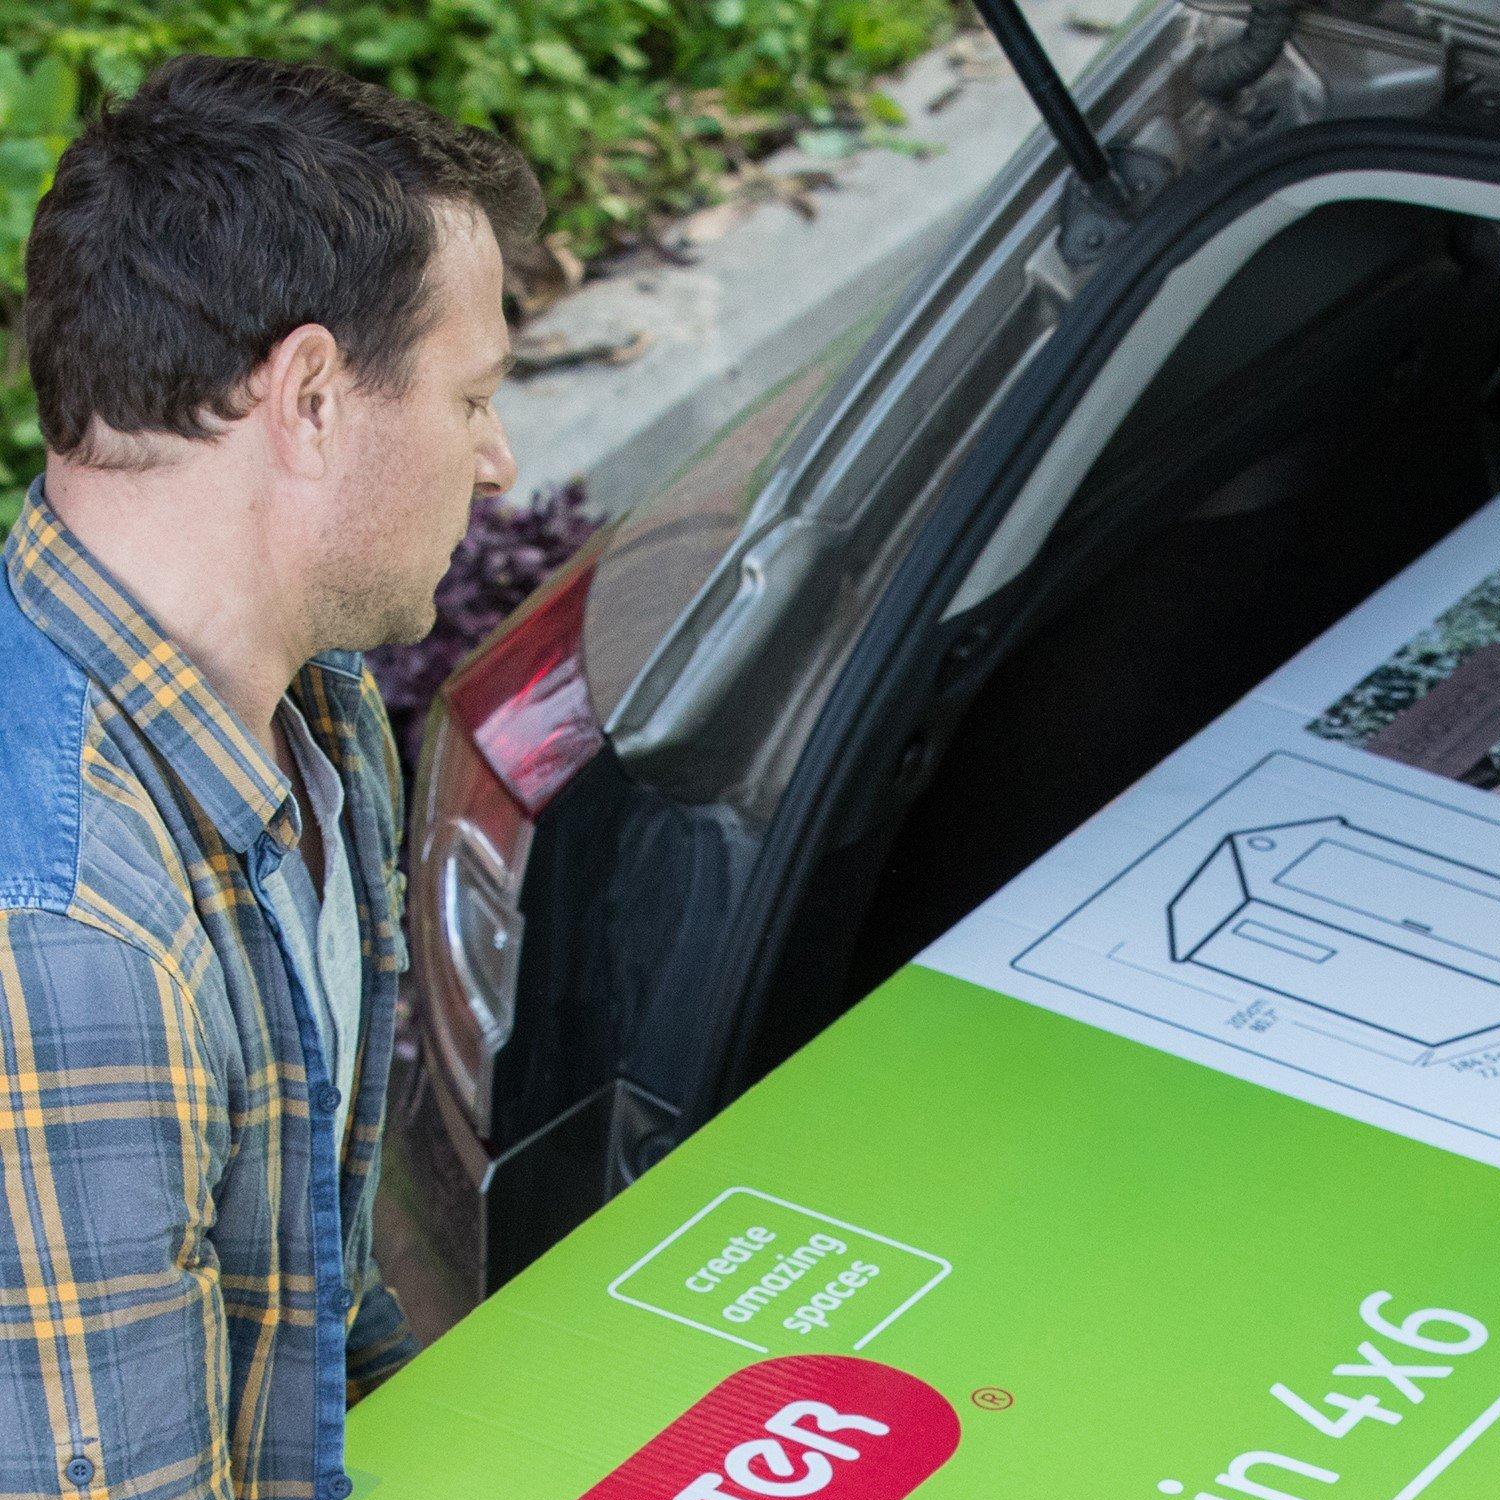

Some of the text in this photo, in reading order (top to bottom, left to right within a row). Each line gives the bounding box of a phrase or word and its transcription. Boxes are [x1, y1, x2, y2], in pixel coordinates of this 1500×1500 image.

[685, 1225, 776, 1294] create
[722, 1232, 847, 1323] amazing
[783, 1259, 880, 1334] spaces
[1270, 1290, 1489, 1440] 4x6
